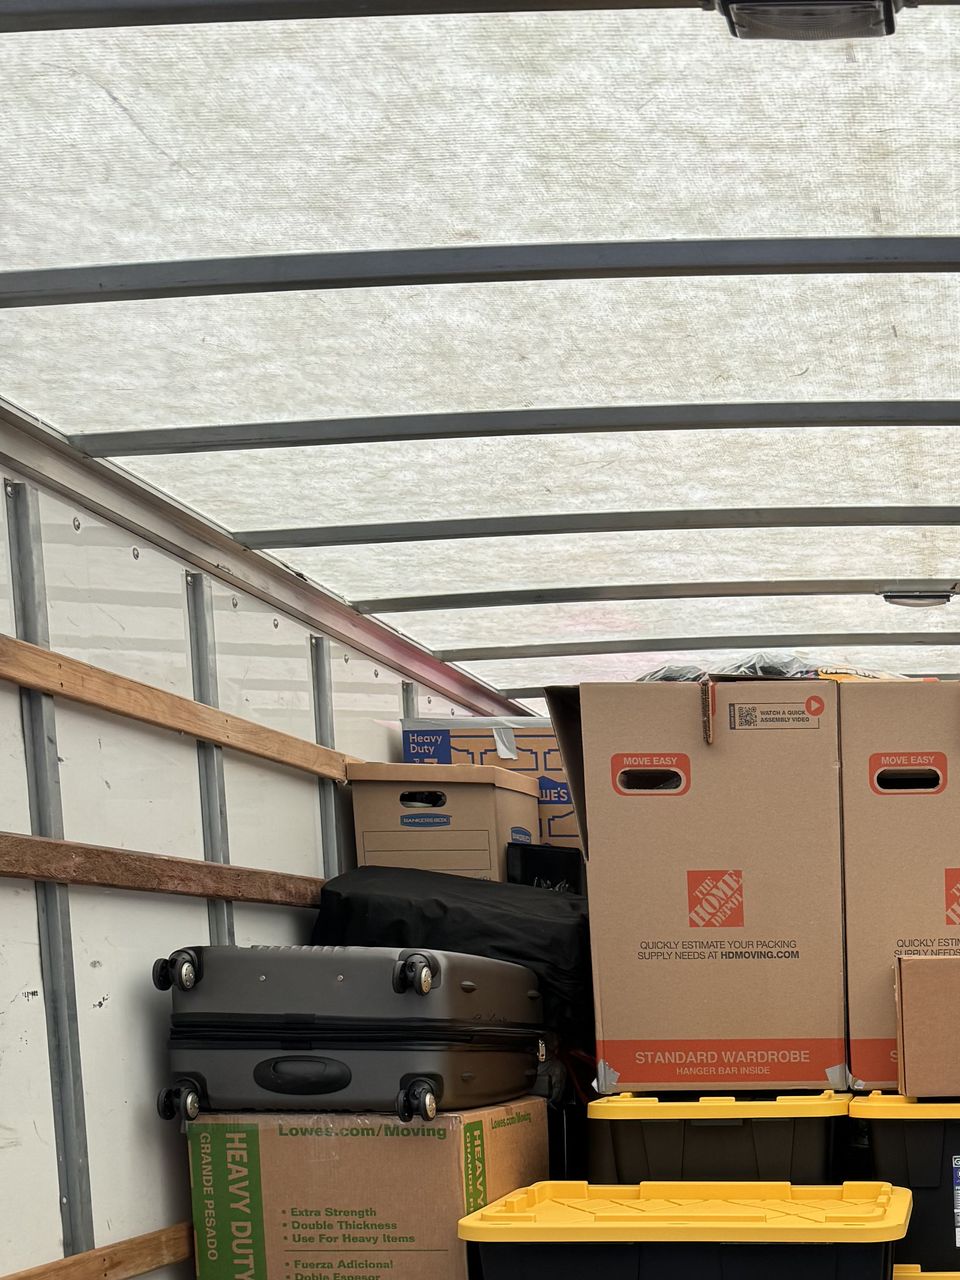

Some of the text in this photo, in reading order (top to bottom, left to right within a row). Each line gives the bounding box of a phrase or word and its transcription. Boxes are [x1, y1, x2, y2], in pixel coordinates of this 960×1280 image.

[409, 733, 442, 745] Heavy
[410, 744, 435, 755] Duty
[623, 757, 678, 766] MOVE EASY
[881, 756, 935, 765] MOVE EASY
[537, 787, 568, 802] WE'S
[693, 876, 717, 899] THE
[689, 870, 744, 927] HOME
[710, 891, 744, 926] DEPOT
[640, 940, 797, 950] QUICKLY ESTIMATE YOUR PACKING
[896, 939, 936, 948] QUICKLY
[637, 951, 800, 960] SUPPLY NEEDS AT HDMOVING.COM
[635, 1050, 810, 1064] STANDARD WARDROBE
[676, 1066, 770, 1076] HANGER BAR INSIDE
[278, 1124, 447, 1140] Lowes.com/Moving
[473, 1130, 484, 1206] HEAVY
[225, 1133, 250, 1216] HEAVY
[200, 1133, 218, 1261] GRANDE PESADO
[291, 1207, 376, 1219] Extra Strength
[291, 1221, 397, 1230] Double Thickness
[293, 1234, 415, 1245] Use For Heavy Items
[294, 1260, 393, 1269] Fuerza Adicional
